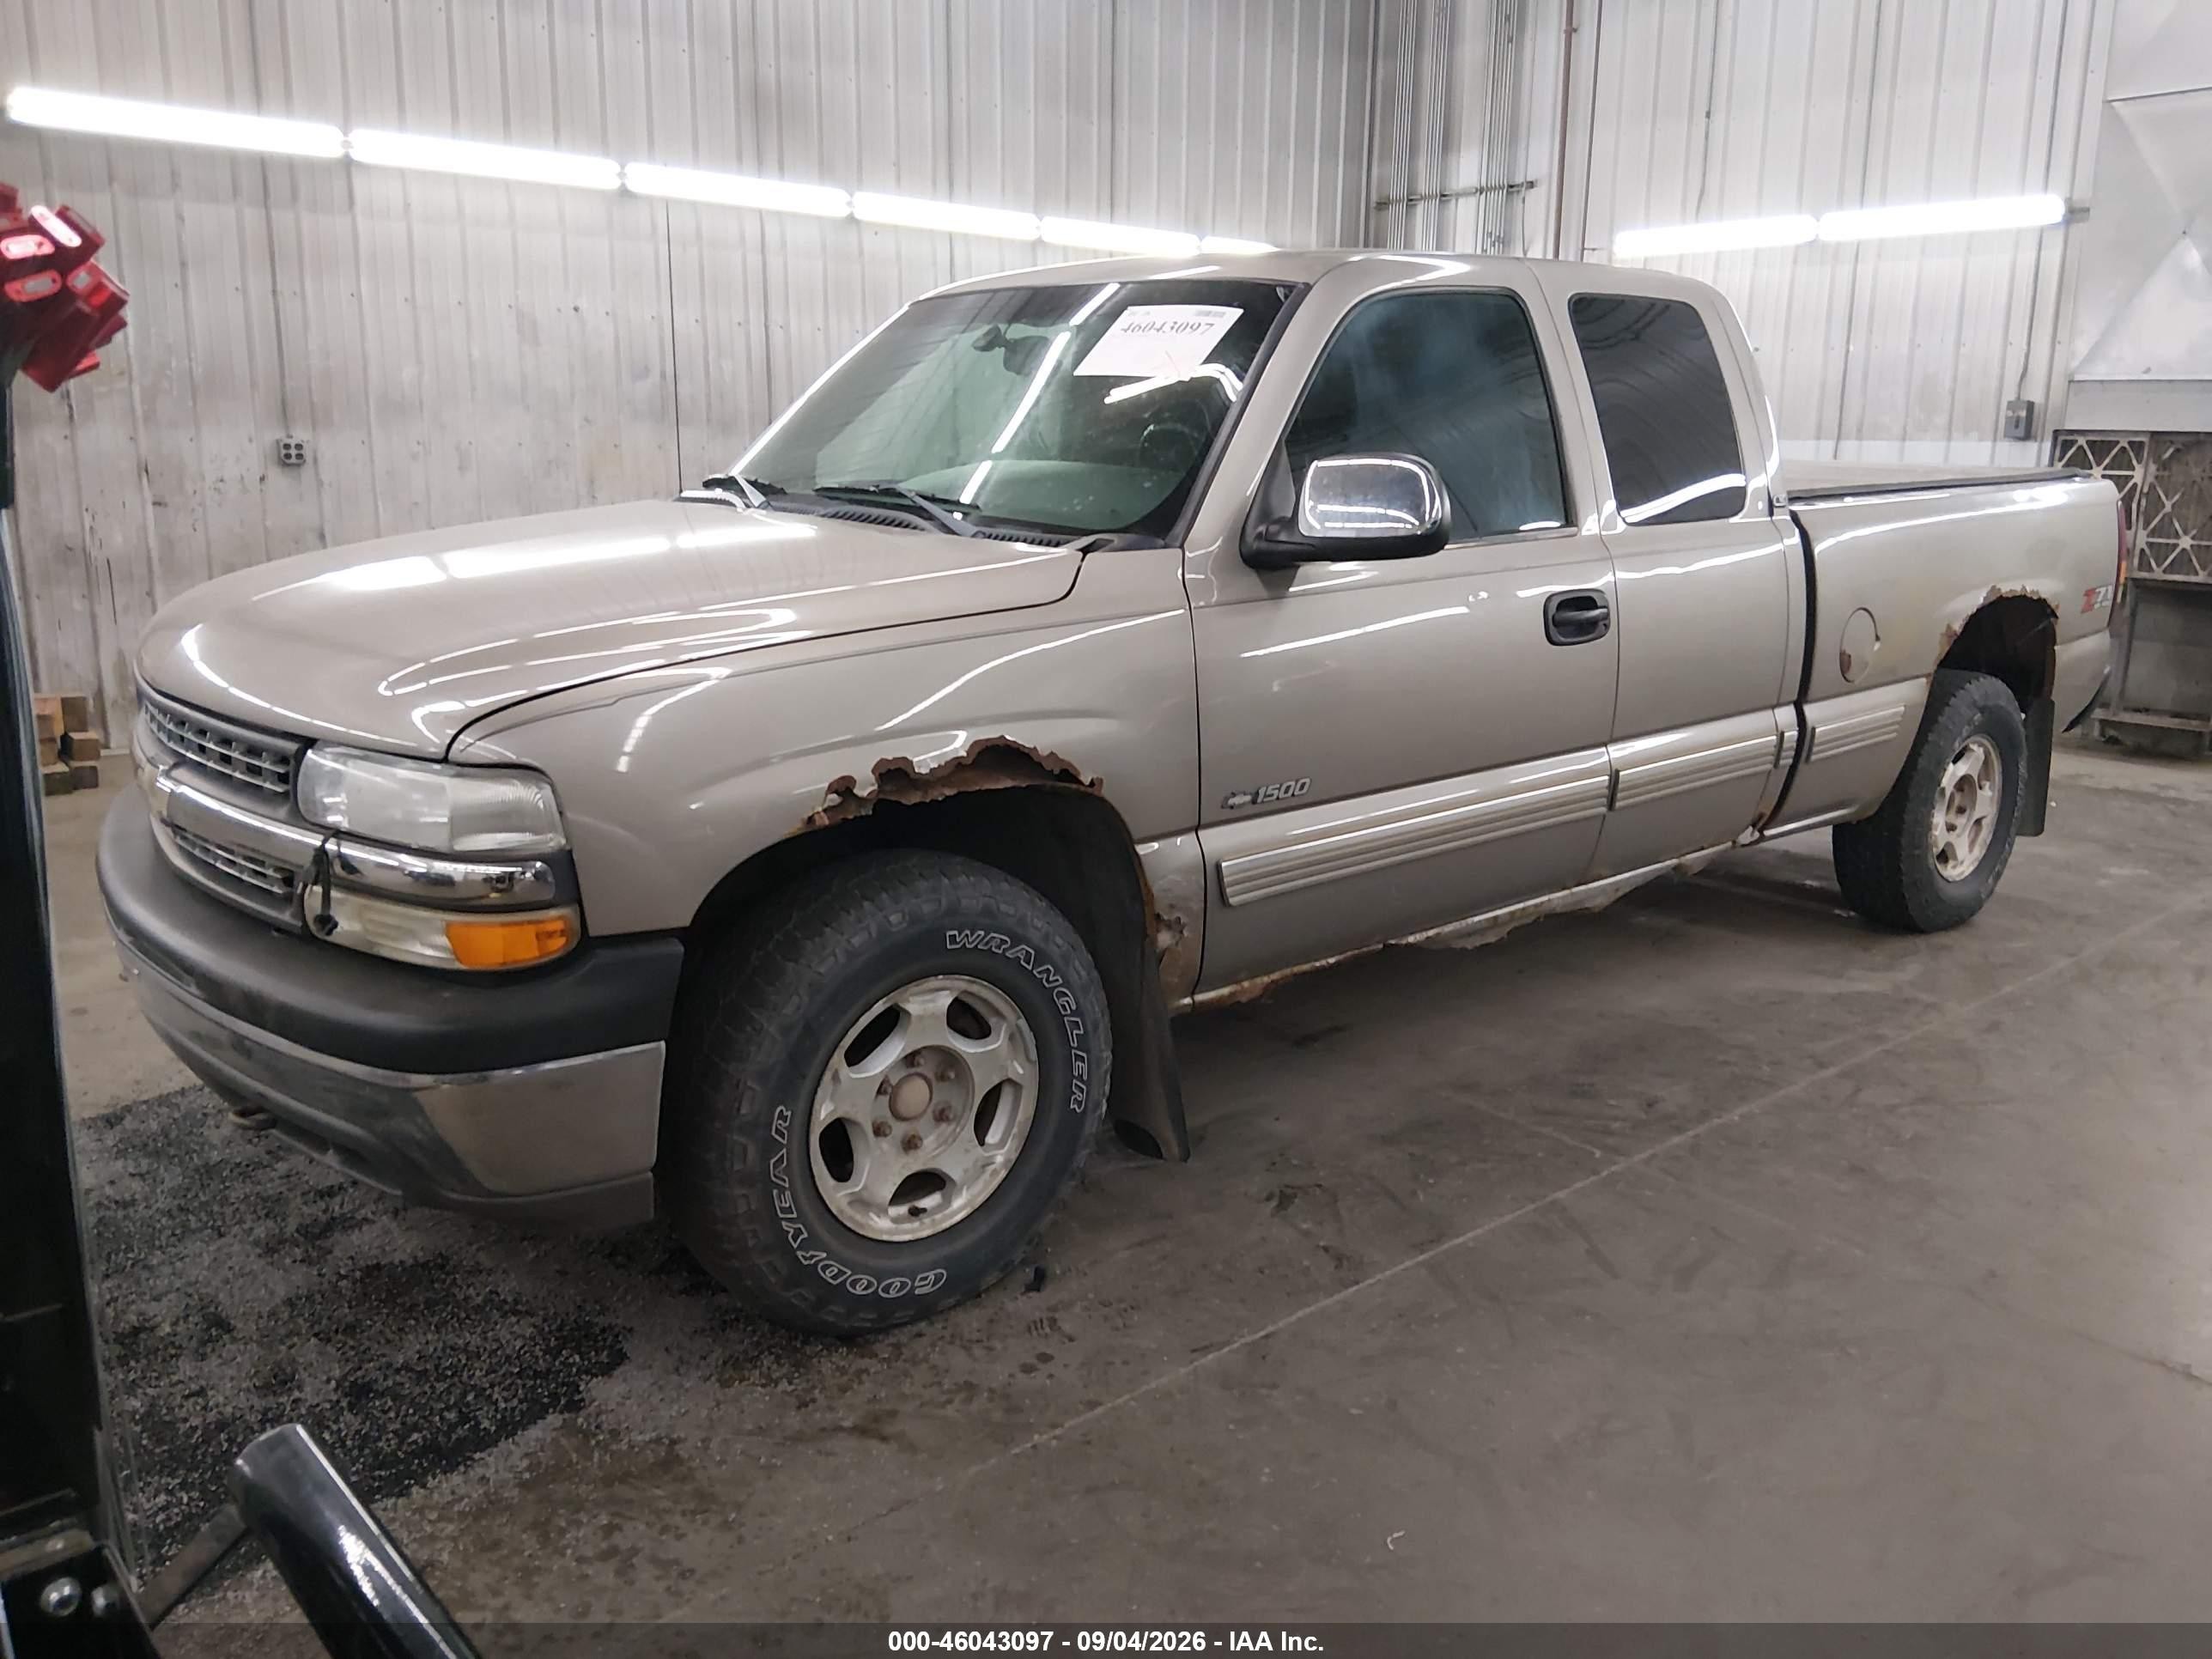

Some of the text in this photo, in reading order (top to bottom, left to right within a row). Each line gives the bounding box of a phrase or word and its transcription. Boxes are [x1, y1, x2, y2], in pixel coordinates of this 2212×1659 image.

[1121, 320, 1216, 336] 46043097
[1255, 777, 1311, 804] 1500
[946, 929, 1088, 1114] WRANGLER
[770, 1105, 946, 1298] GOODYEAR
